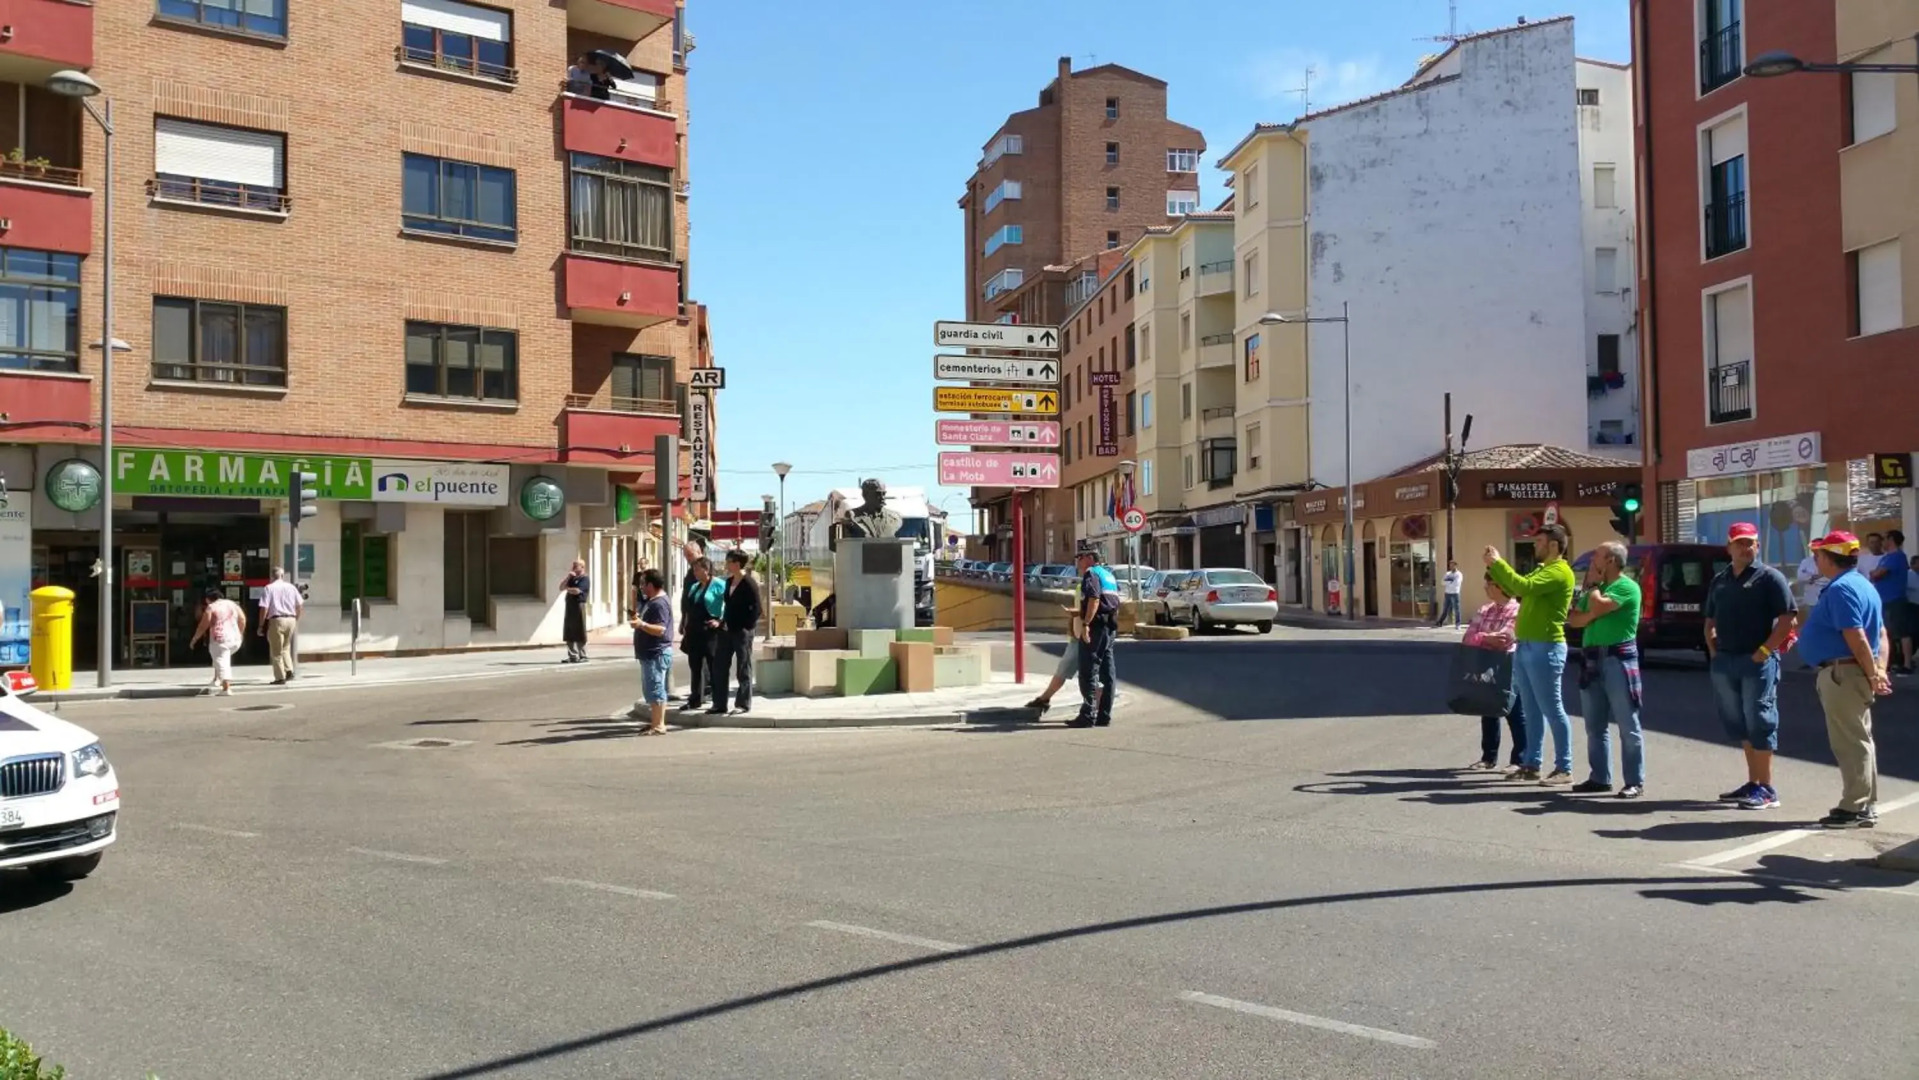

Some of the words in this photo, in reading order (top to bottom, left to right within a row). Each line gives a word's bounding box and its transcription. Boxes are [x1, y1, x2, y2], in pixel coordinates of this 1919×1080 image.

[940, 329, 979, 339] guardia
[982, 330, 1004, 340] civil
[939, 363, 1002, 374] cementerios
[1093, 374, 1119, 383] HOTEL
[942, 432, 967, 441] Santa
[970, 432, 993, 441] Clara
[693, 403, 704, 492] RESTAURANTE
[1098, 447, 1116, 455] BAR
[943, 456, 982, 468] castillo
[986, 457, 999, 468] de
[943, 471, 955, 480] La
[960, 471, 985, 481] Mota
[1126, 514, 1142, 524] 40
[0, 810, 22, 823] 384
